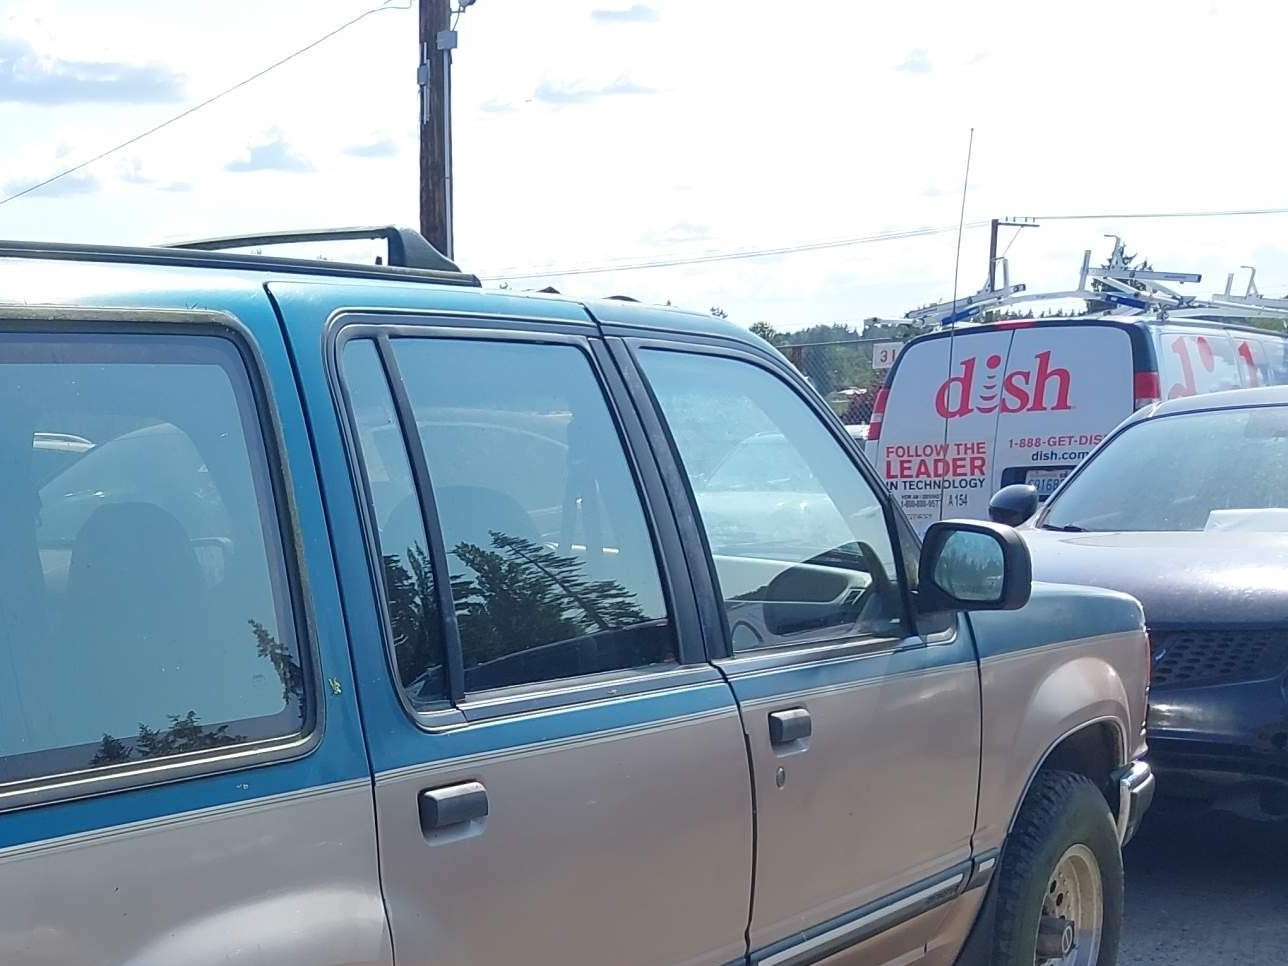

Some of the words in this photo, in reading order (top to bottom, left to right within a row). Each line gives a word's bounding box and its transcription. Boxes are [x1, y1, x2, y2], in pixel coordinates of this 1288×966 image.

[935, 350, 1072, 419] dish
[886, 444, 949, 458] FOLLOW
[954, 441, 986, 456] THE
[1008, 435, 1106, 448] 1-888-GET-DIS
[886, 457, 986, 479] LEADER
[902, 479, 986, 490] TECHNOLOGY
